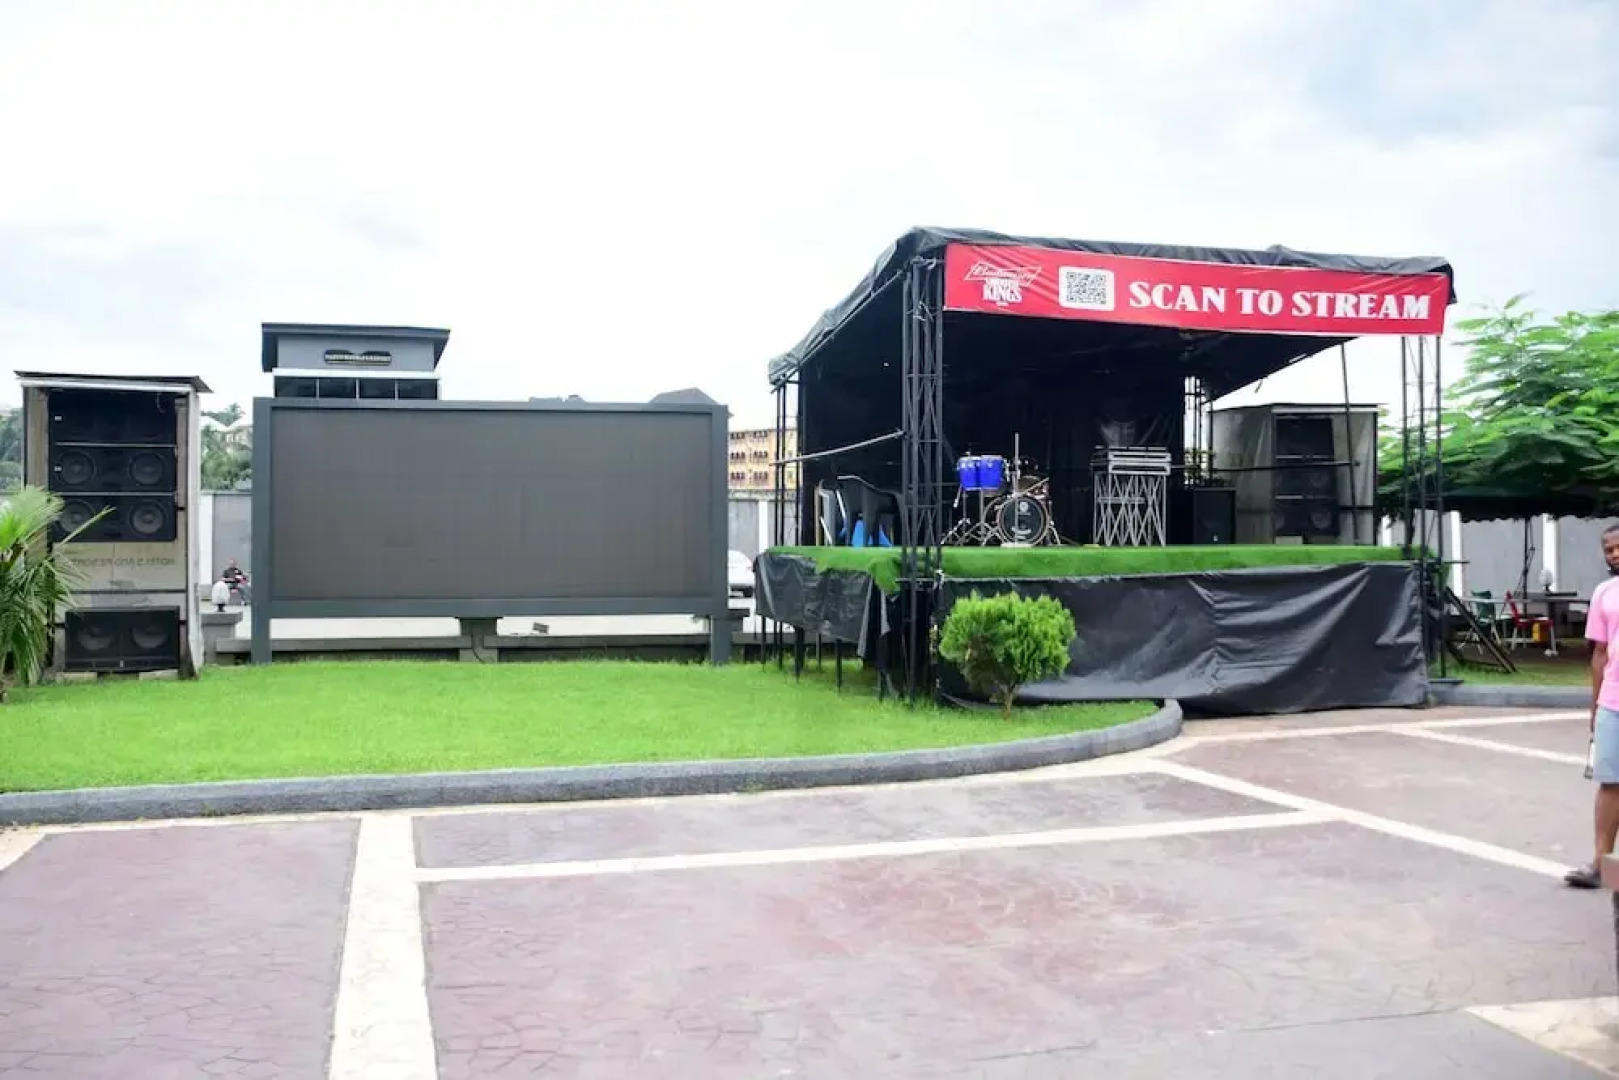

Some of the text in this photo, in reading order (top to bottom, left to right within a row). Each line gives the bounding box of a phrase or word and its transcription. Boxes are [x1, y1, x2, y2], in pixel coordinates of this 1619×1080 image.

[983, 284, 1023, 303] KINGS
[1129, 281, 1430, 319] SCAN TO STREAM
